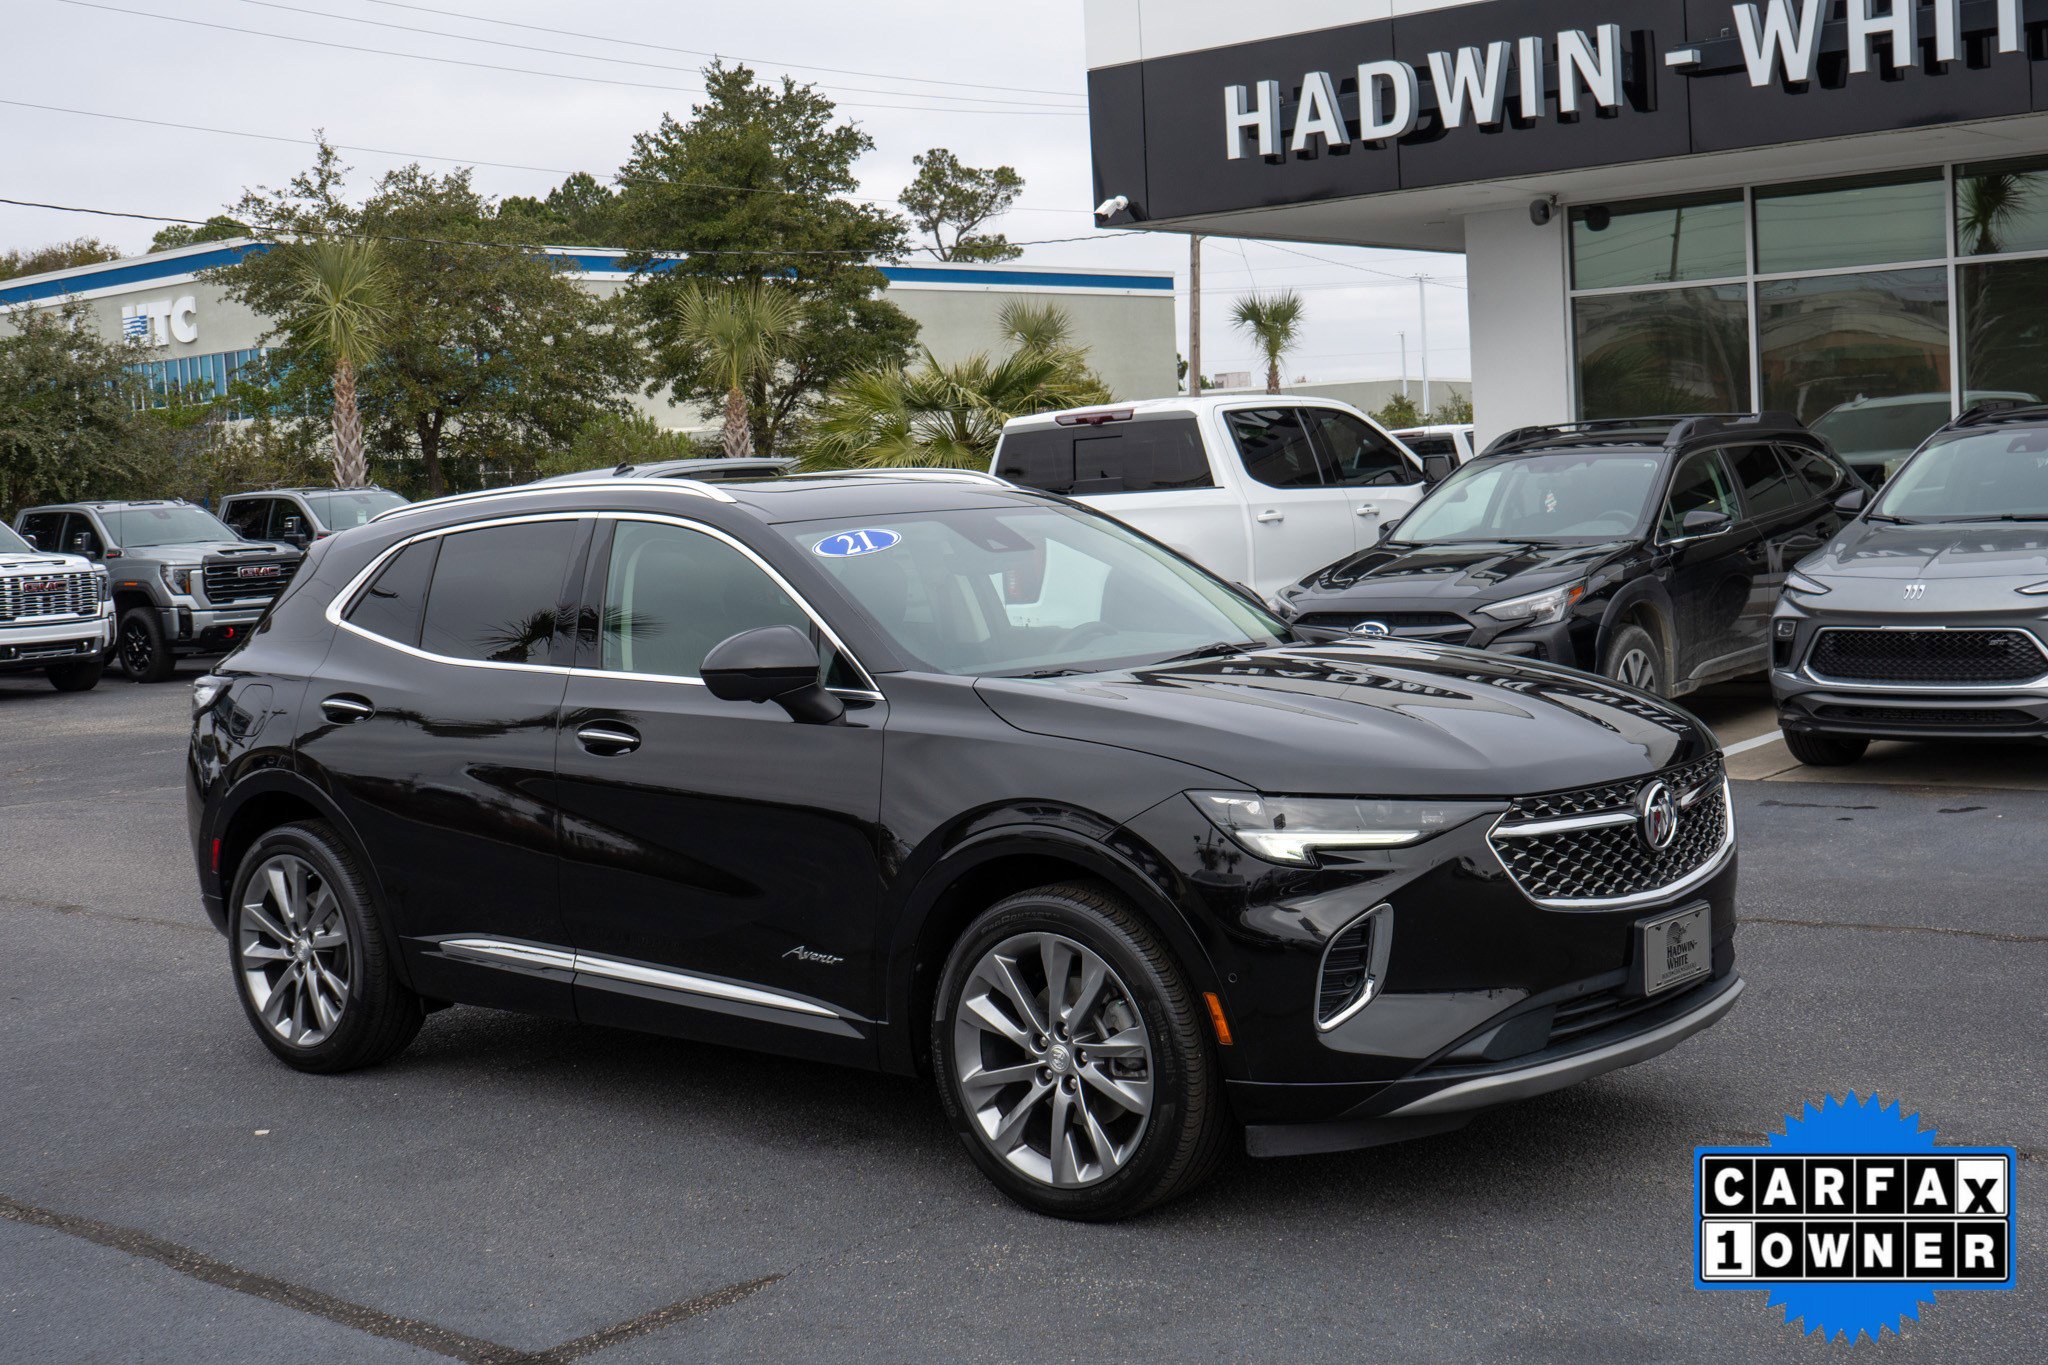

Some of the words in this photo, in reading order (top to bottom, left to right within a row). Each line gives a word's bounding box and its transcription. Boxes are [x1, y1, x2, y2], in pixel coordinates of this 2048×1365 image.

[1225, 24, 1623, 160] HADWIN
[836, 530, 879, 555] 21
[241, 566, 281, 578] GMC
[24, 580, 68, 593] GMC
[1666, 953, 1688, 970] WHITE
